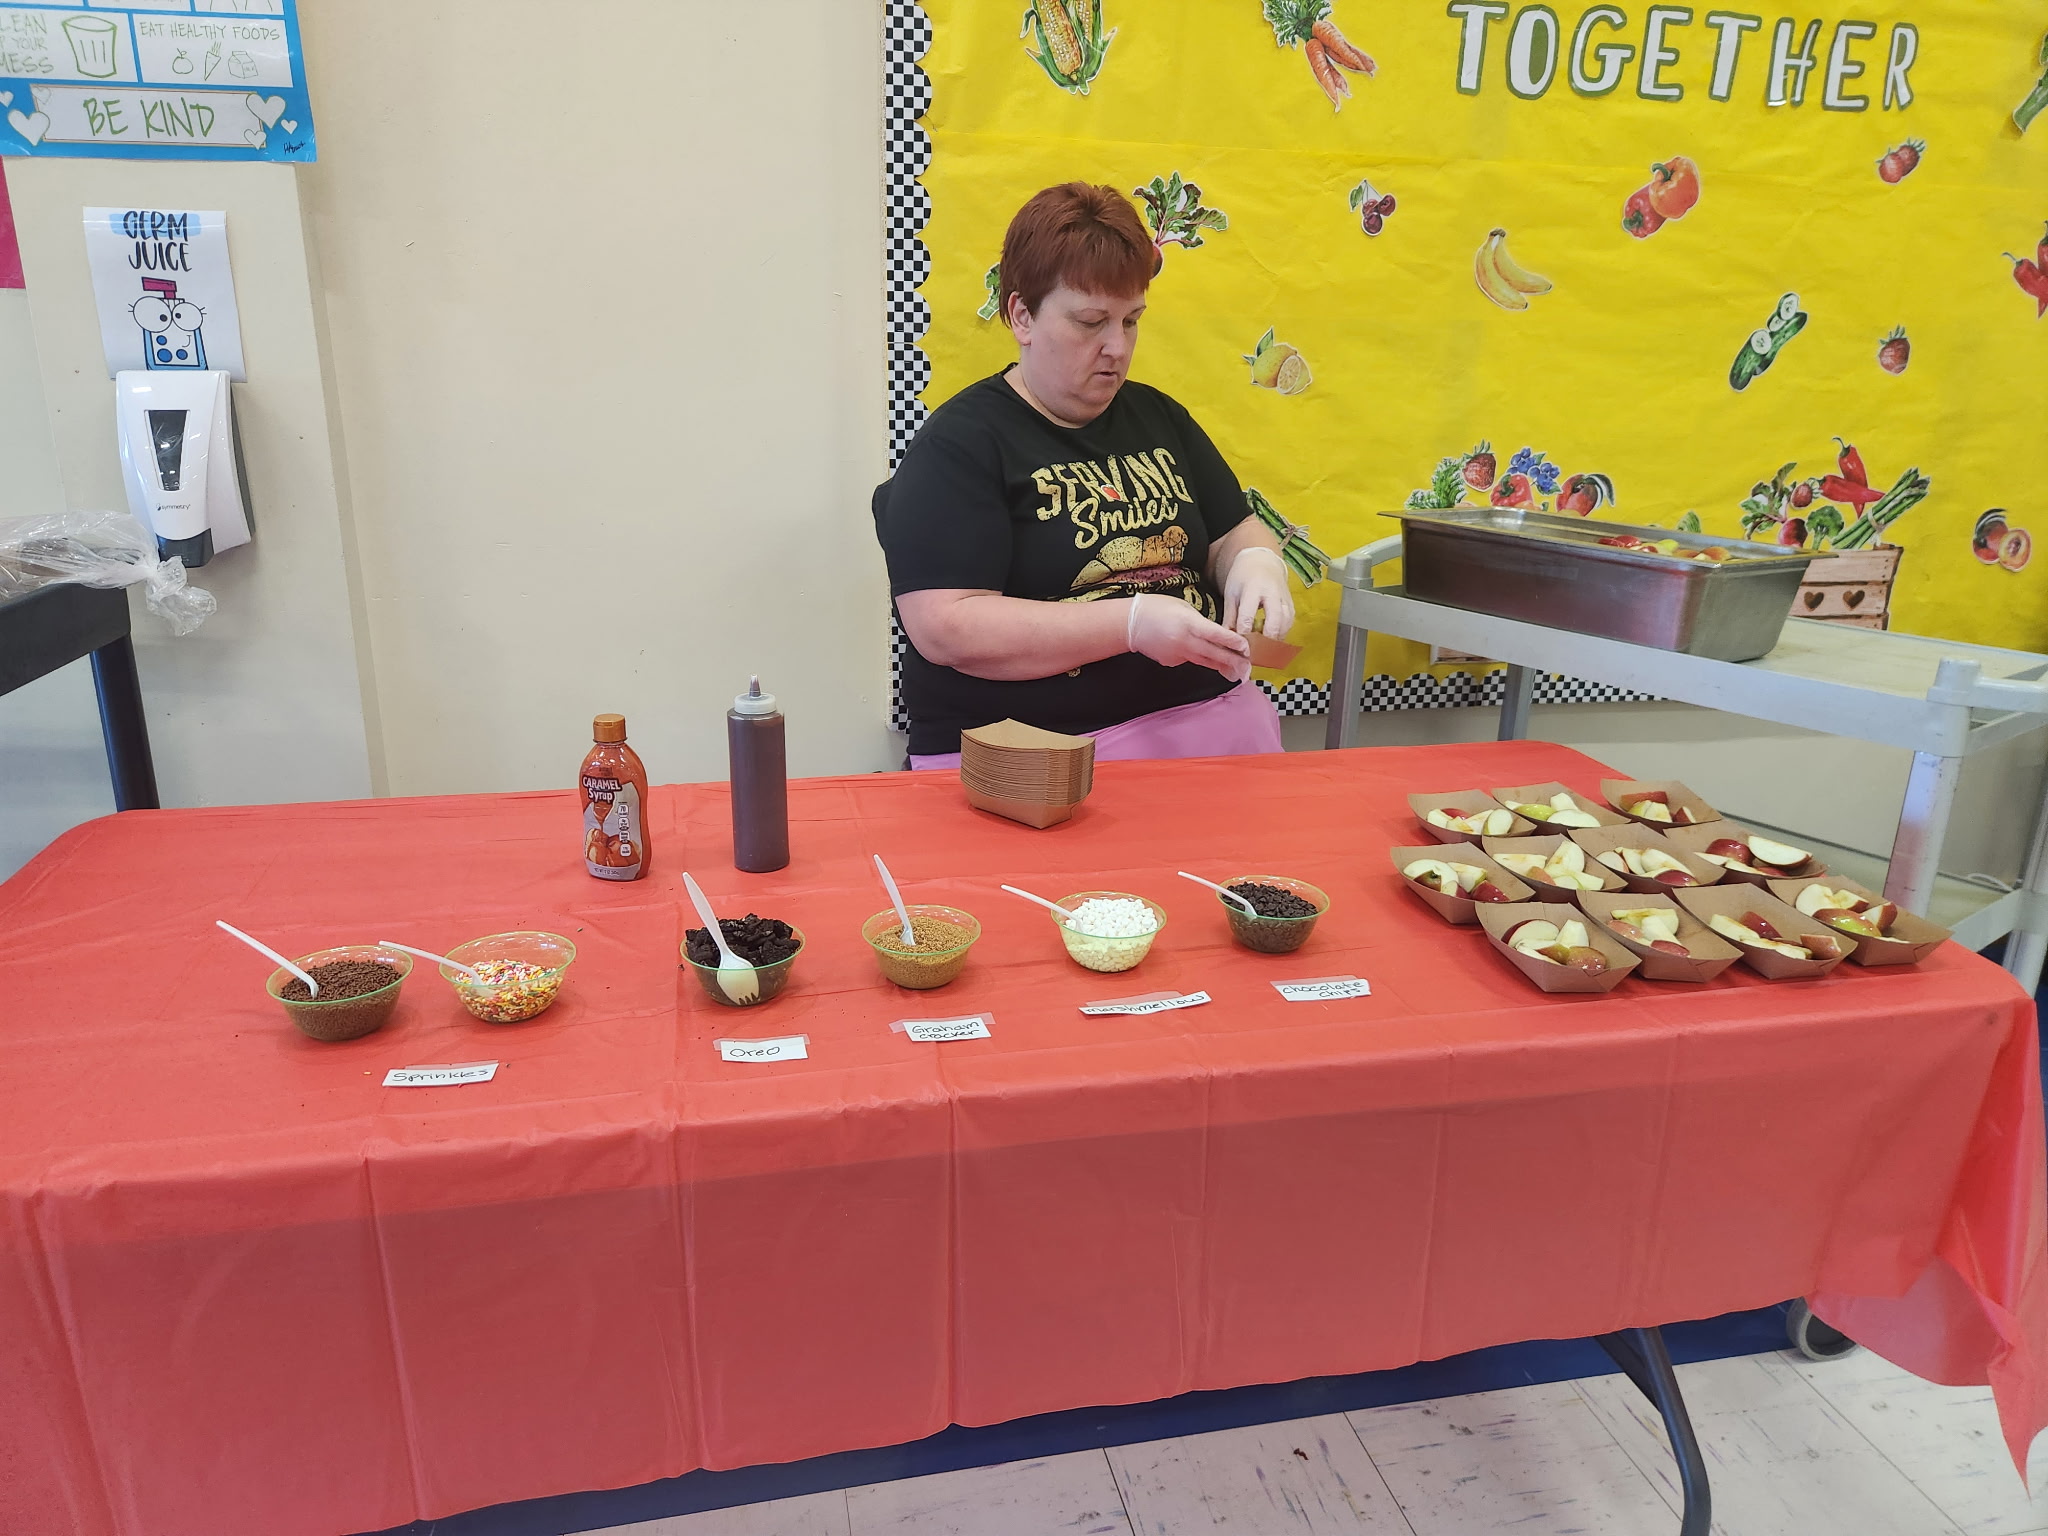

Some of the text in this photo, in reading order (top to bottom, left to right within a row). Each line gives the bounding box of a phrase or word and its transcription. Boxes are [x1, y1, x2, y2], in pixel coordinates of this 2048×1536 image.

[0, 13, 47, 36] LEAN
[140, 21, 280, 41] EAT HEALTHY FOODS
[11, 36, 48, 51] YOUR
[1446, 0, 1919, 112] TOGETHER
[83, 97, 215, 138] BE KIND
[122, 210, 189, 242] GERM
[128, 241, 193, 272] JUICE
[1030, 447, 1194, 521] SERVING
[1071, 495, 1179, 549] Smiles
[583, 776, 621, 790] CARAMEL
[588, 787, 613, 803] Syrup
[911, 1021, 980, 1034] Graham
